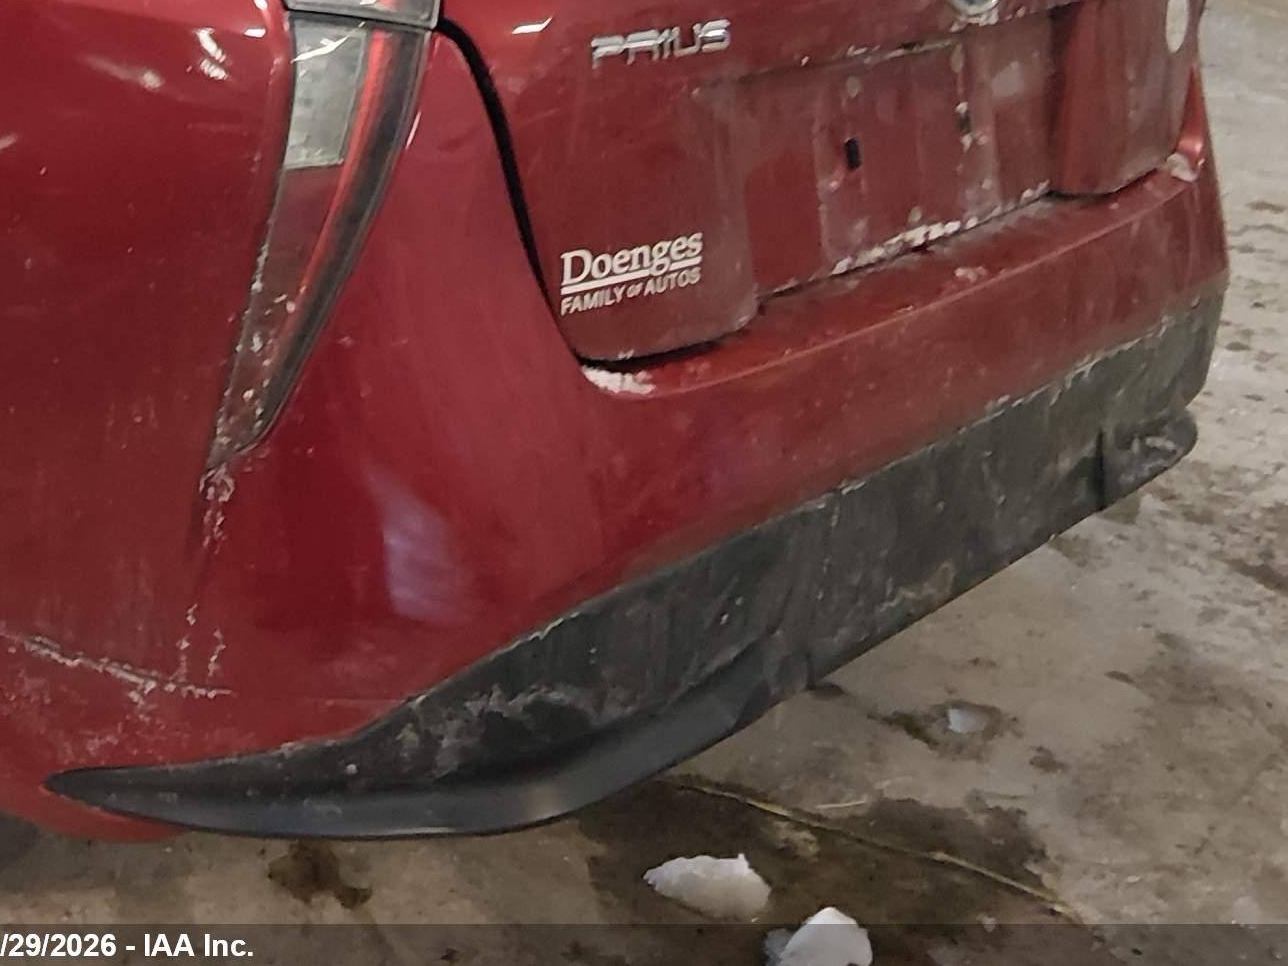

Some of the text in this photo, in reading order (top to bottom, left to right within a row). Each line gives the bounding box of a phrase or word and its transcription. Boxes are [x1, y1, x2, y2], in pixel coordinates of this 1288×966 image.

[591, 19, 730, 69] PRIUS
[560, 232, 703, 285] Doenges
[561, 284, 624, 315] FAMILY
[643, 266, 701, 296] AUTOS
